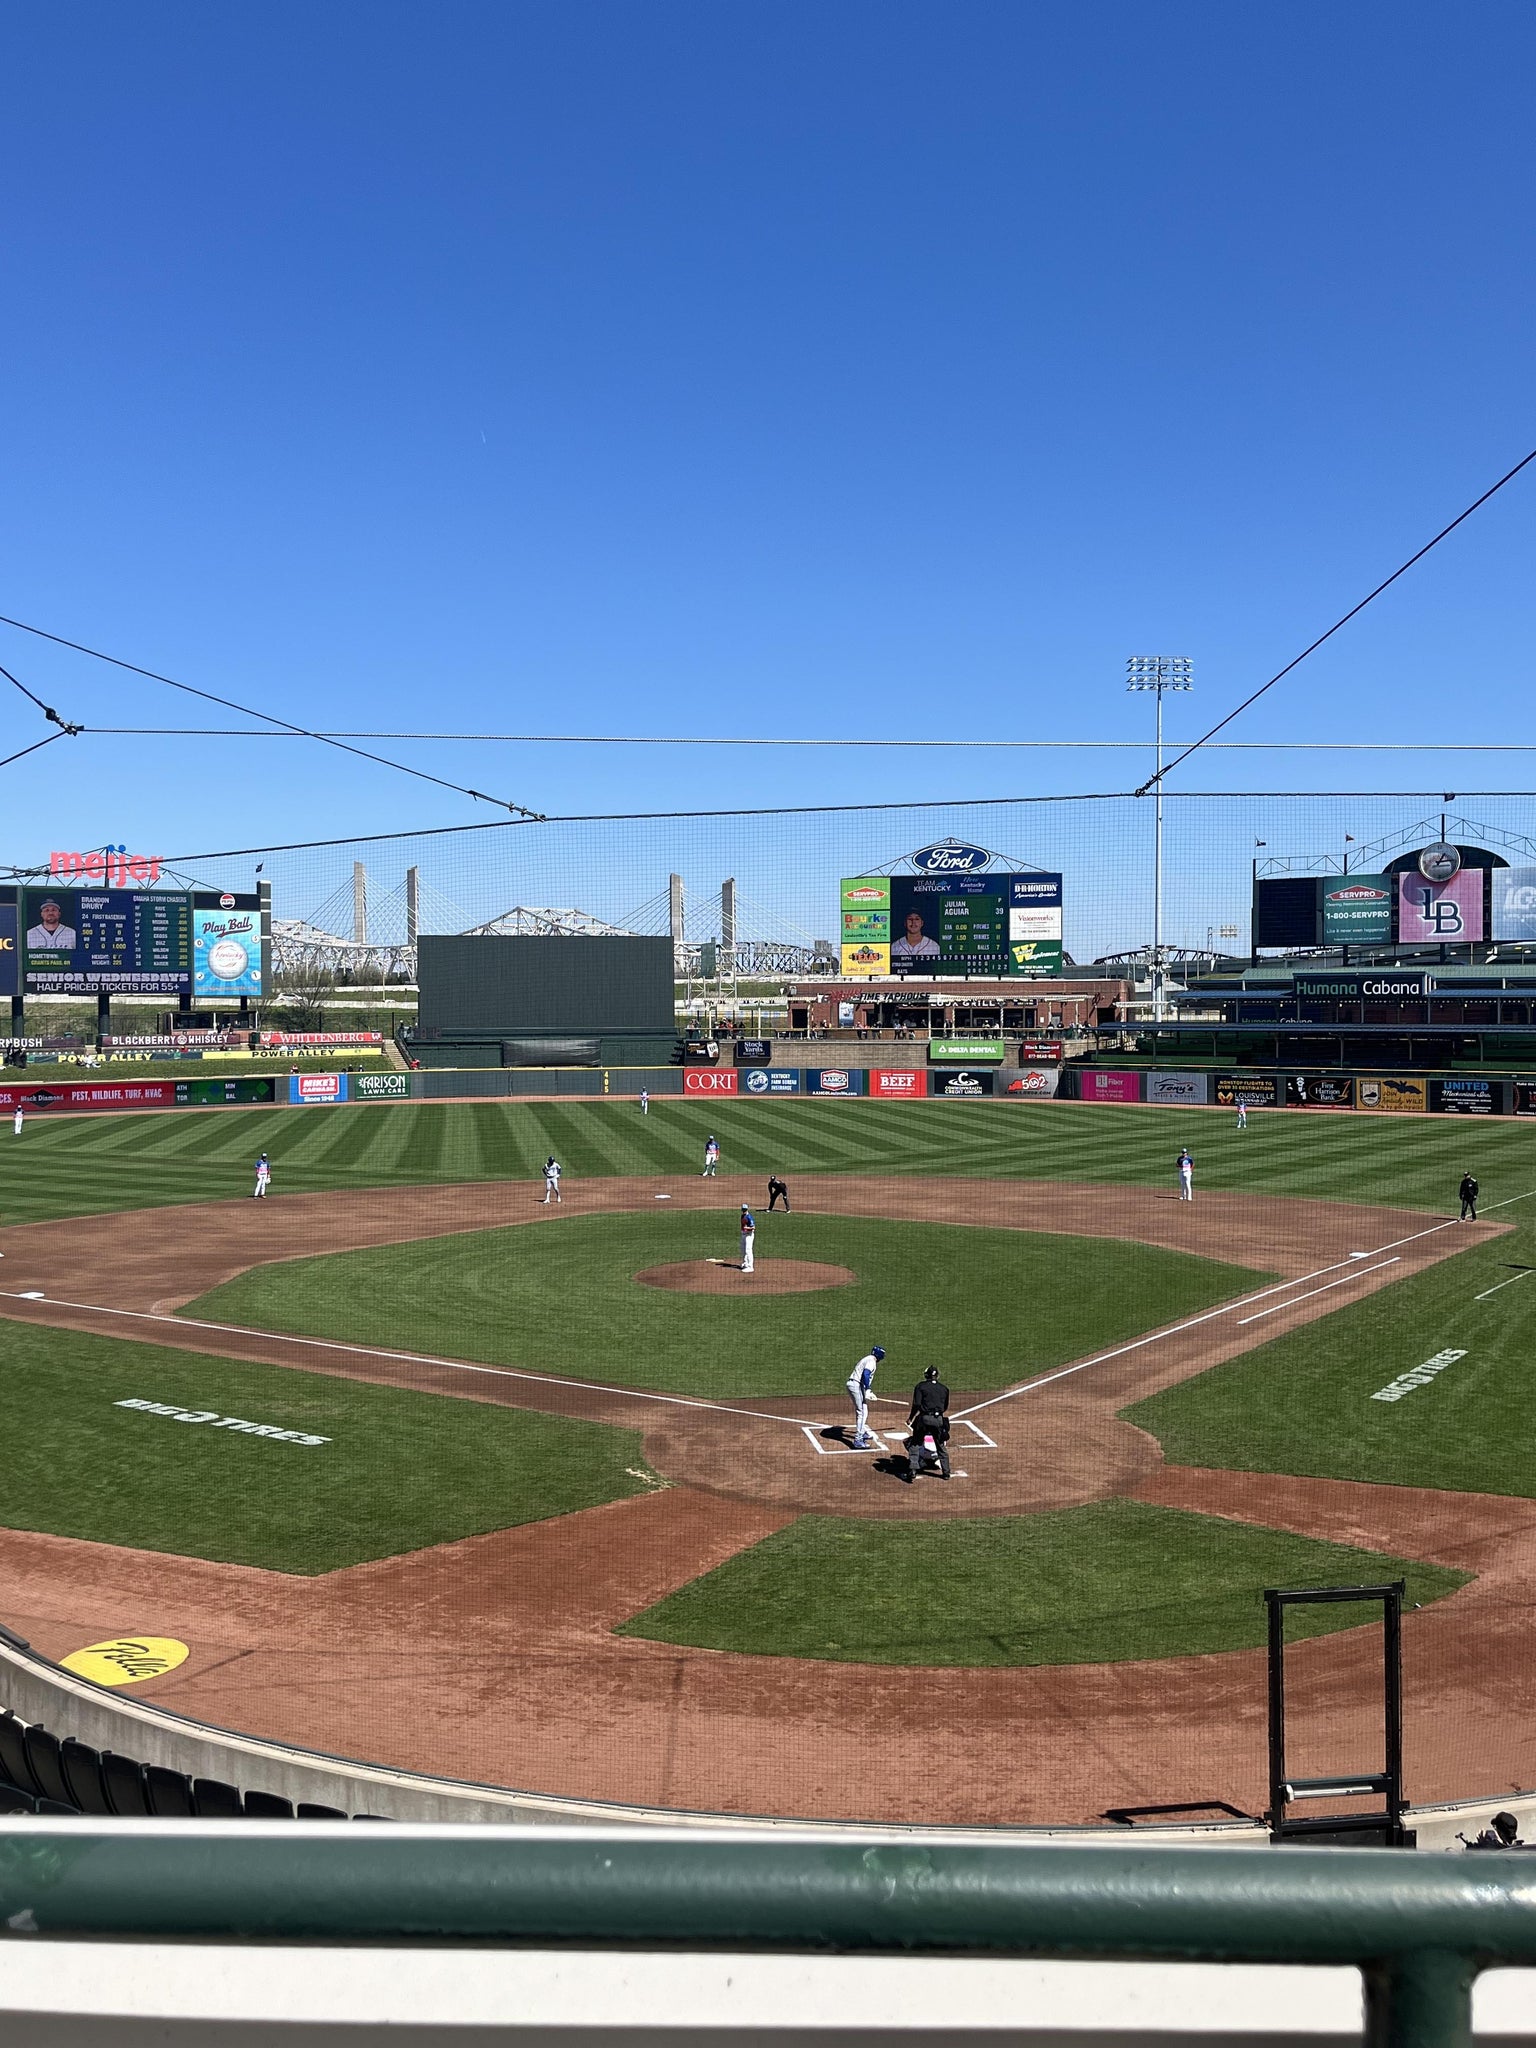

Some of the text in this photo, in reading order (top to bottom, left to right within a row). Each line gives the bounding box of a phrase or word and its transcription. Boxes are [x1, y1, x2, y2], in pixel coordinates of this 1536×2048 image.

[927, 848, 975, 869] Ford
[50, 844, 164, 888] meijer
[1339, 891, 1376, 899] SERVPRO
[944, 908, 970, 916] AGUIAR
[1326, 911, 1390, 919] 1-800-SERVPRO
[844, 914, 888, 923] Bourke
[202, 920, 226, 934] Play
[228, 916, 252, 930] Ball
[845, 923, 887, 931] Accounting
[26, 972, 189, 983] SENIOR WEDNESDAYS
[36, 983, 180, 991] HALF PRICED TICKETS FOR 55+
[1296, 980, 1420, 995] Humana Cabana
[860, 992, 880, 1001] TIME
[883, 992, 930, 1000] TAPHOUSE
[112, 1034, 229, 1045] BLACKBERRY WHISKEY
[280, 1032, 365, 1043] WHITTENBERG
[109, 1053, 153, 1062] ALLEY
[296, 1049, 336, 1057] ALLEY
[303, 1077, 336, 1087] MIKE'S
[363, 1075, 406, 1089] FARISON
[686, 1073, 737, 1090] CORT
[1443, 1081, 1489, 1091] UNITED
[1158, 1083, 1194, 1094] Tony's
[1315, 1087, 1340, 1095] Harrison
[38, 1093, 64, 1101] Diamond
[71, 1088, 163, 1102] PEST, WILDLIFE, TURF, HVAC
[1234, 1092, 1275, 1100] LOUISVILLE
[1320, 1093, 1335, 1101] Bank
[1370, 1347, 1469, 1402] BIG O TIRES
[112, 1398, 333, 1446] BIG O TIRES
[85, 1642, 170, 1677] Pella
